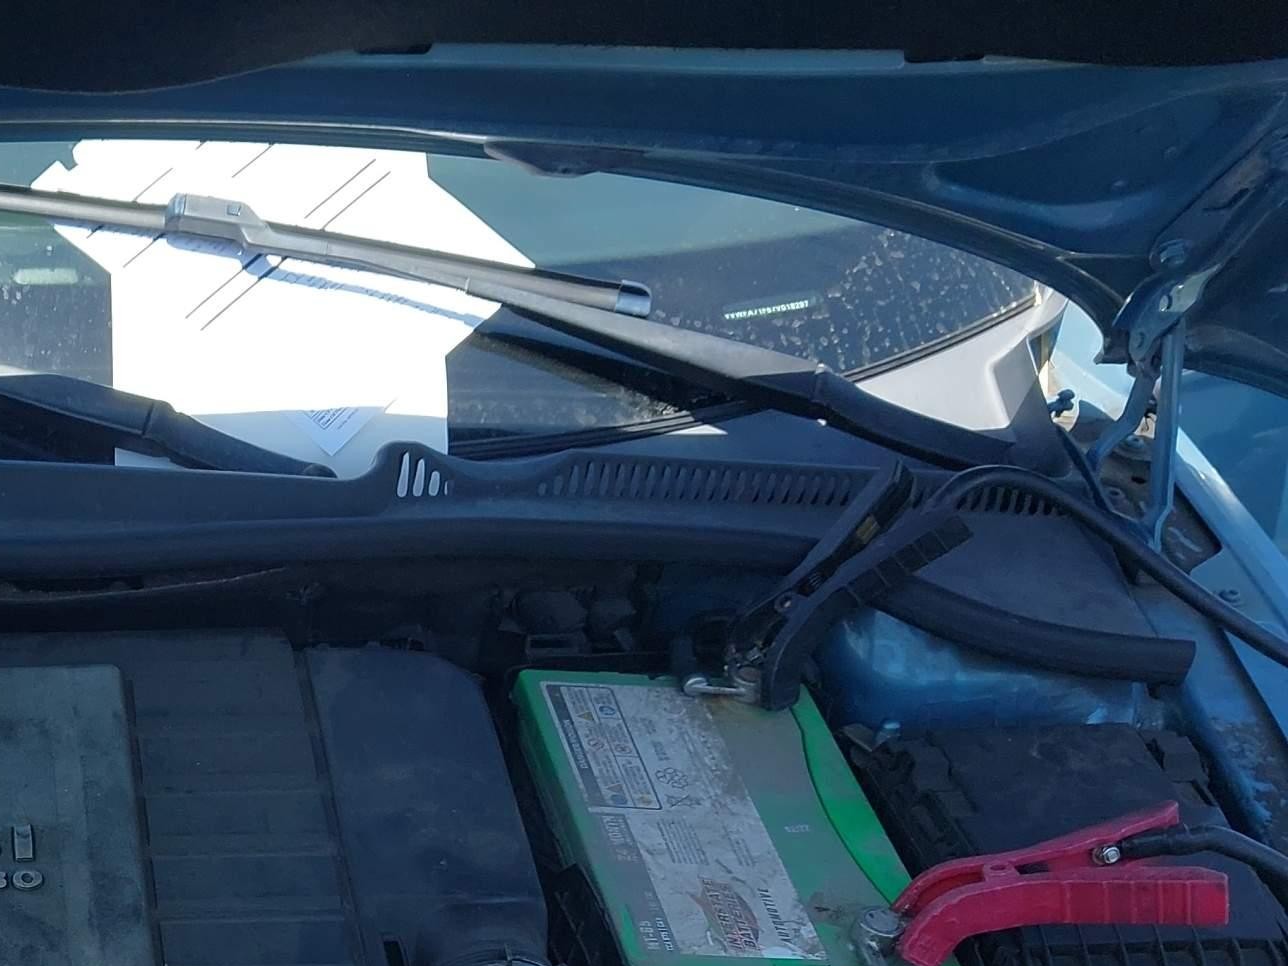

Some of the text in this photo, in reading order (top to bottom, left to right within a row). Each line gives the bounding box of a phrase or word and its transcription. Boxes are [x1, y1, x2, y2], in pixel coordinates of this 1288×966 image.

[699, 878, 743, 949] INTERSTATE
[716, 882, 759, 948] BATTERIES
[759, 888, 792, 942] AUTOMOTIVE
